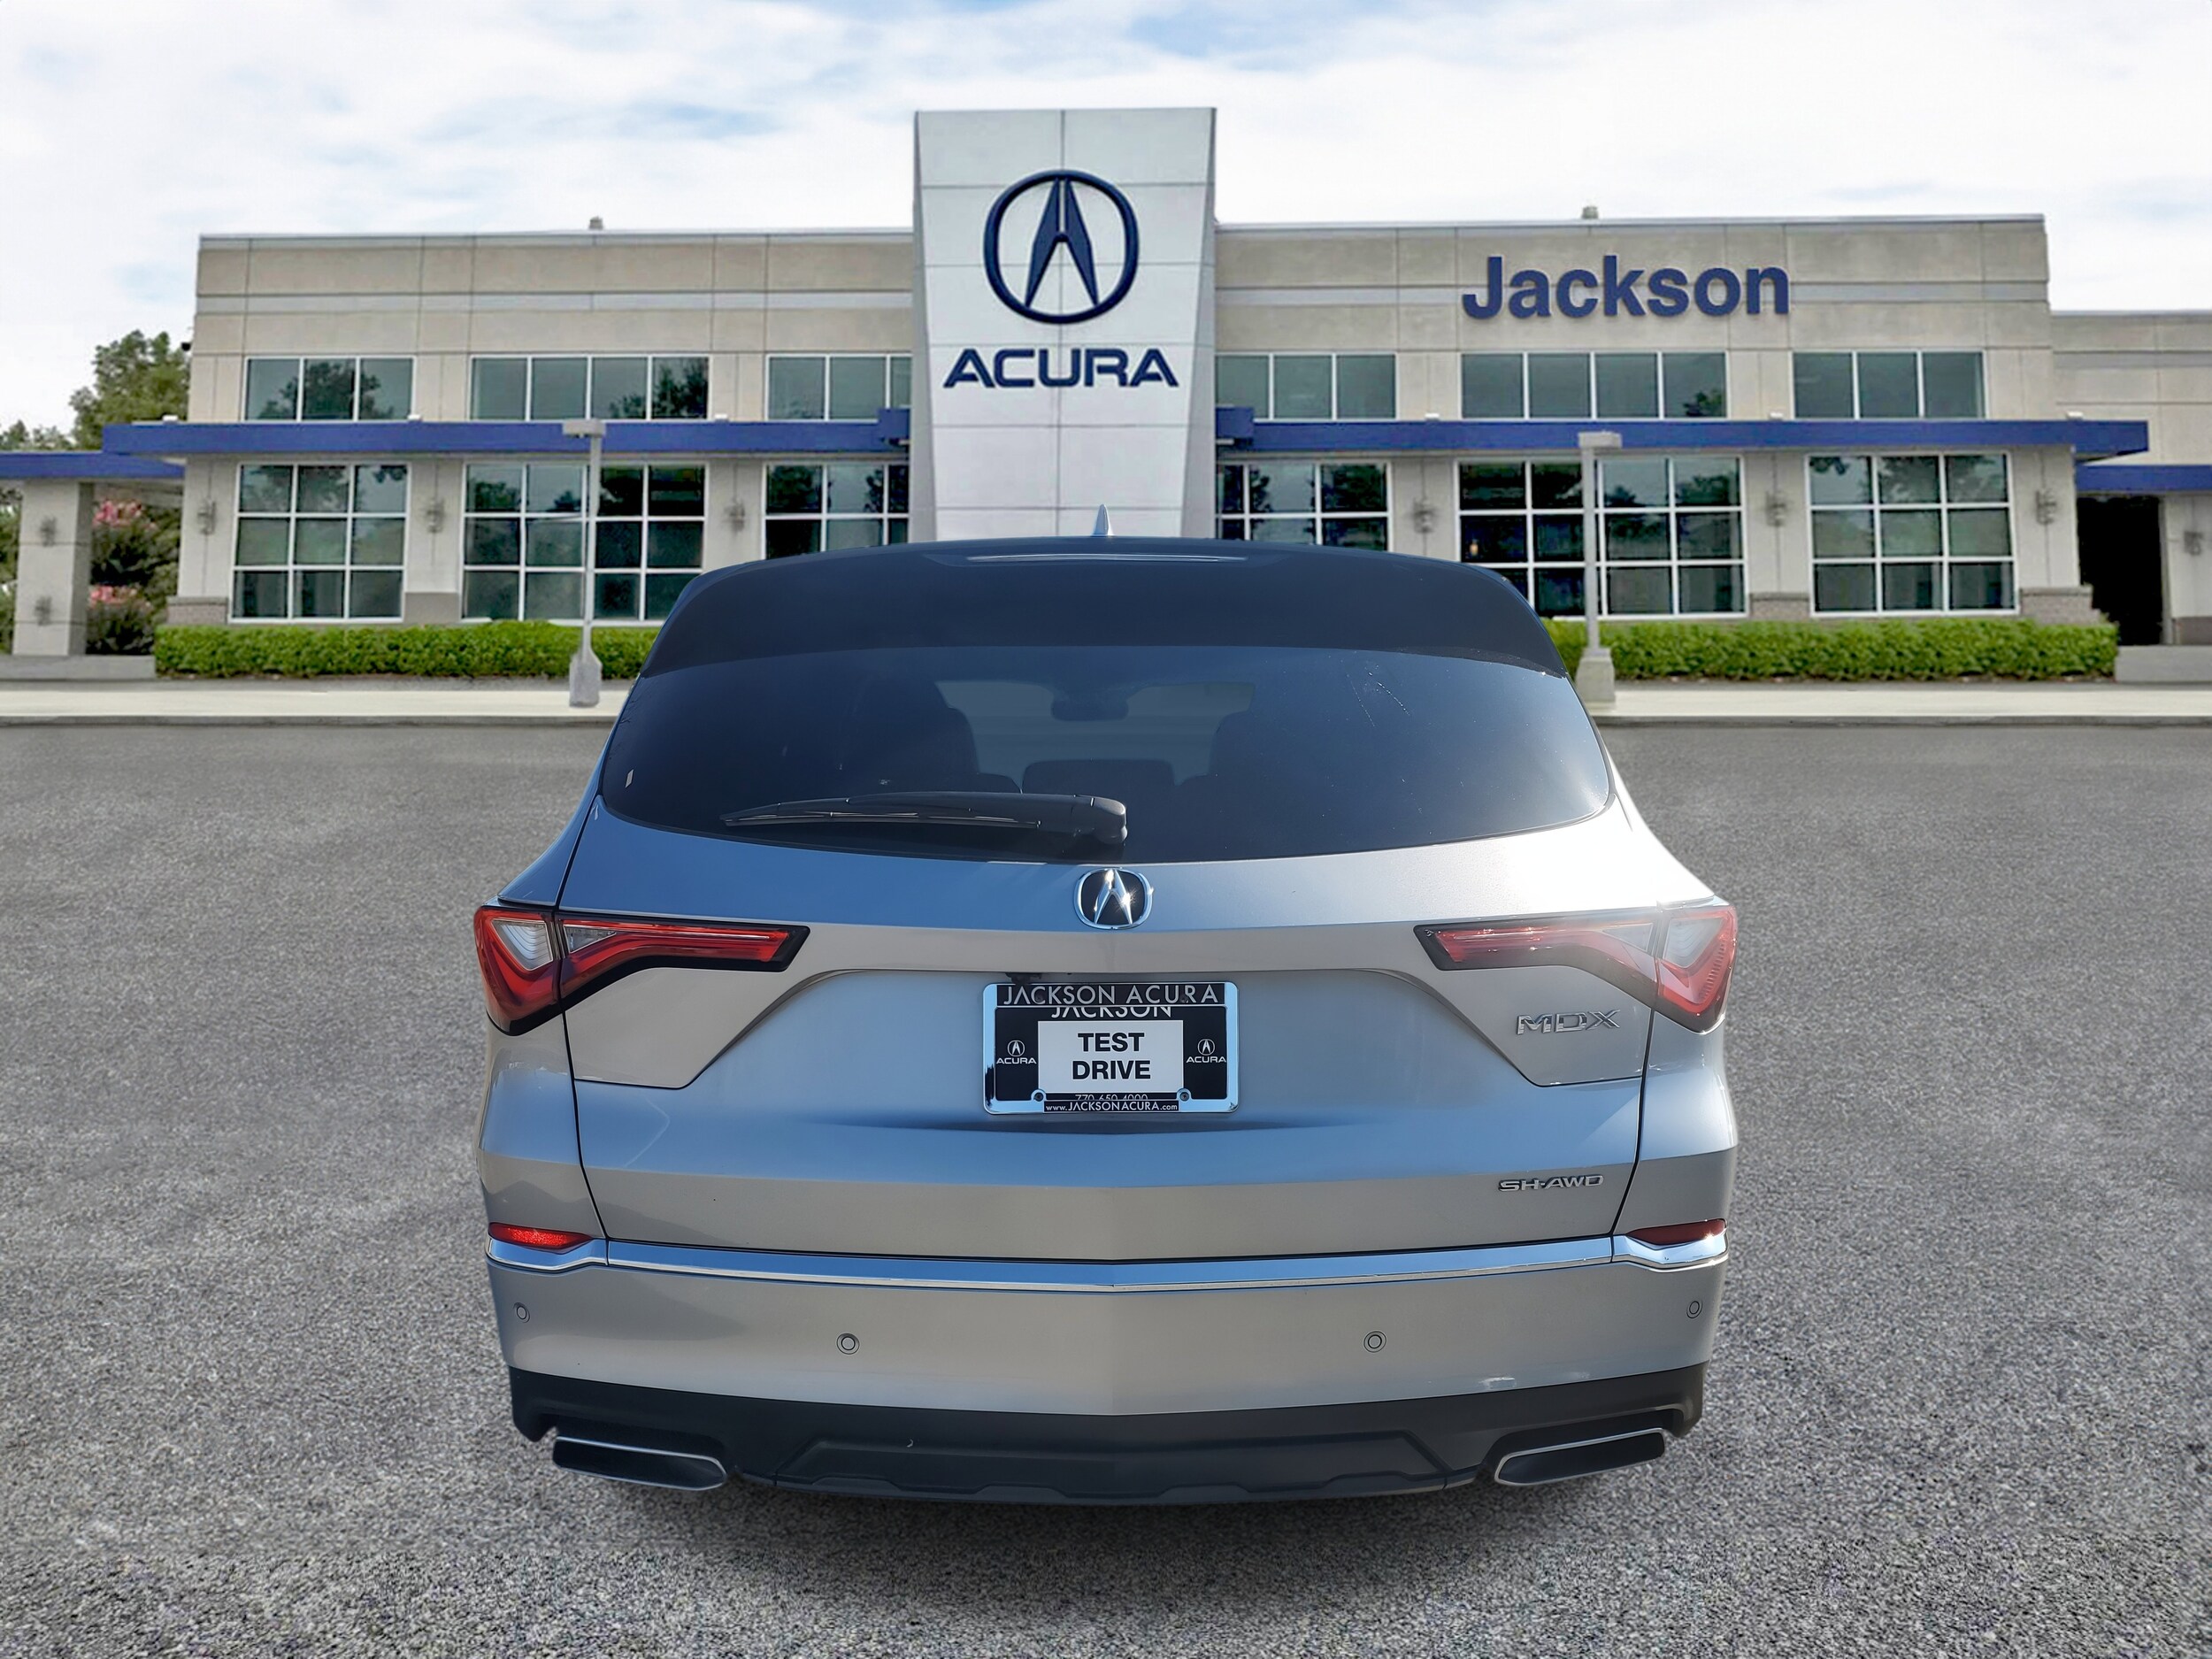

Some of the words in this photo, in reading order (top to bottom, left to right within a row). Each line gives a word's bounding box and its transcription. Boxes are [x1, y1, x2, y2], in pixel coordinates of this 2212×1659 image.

[1463, 255, 1790, 319] Jackson
[943, 348, 1179, 388] ACURA
[1003, 985, 1115, 1004] JACKSON
[1125, 984, 1218, 1003] ACURA
[1516, 1010, 1621, 1035] MDX
[1078, 1032, 1145, 1052] TEST
[1072, 1060, 1151, 1079] DRIVE
[1046, 1101, 1178, 1111] www.JACKSONACURA.com
[1499, 1174, 1604, 1192] SH-AWD
